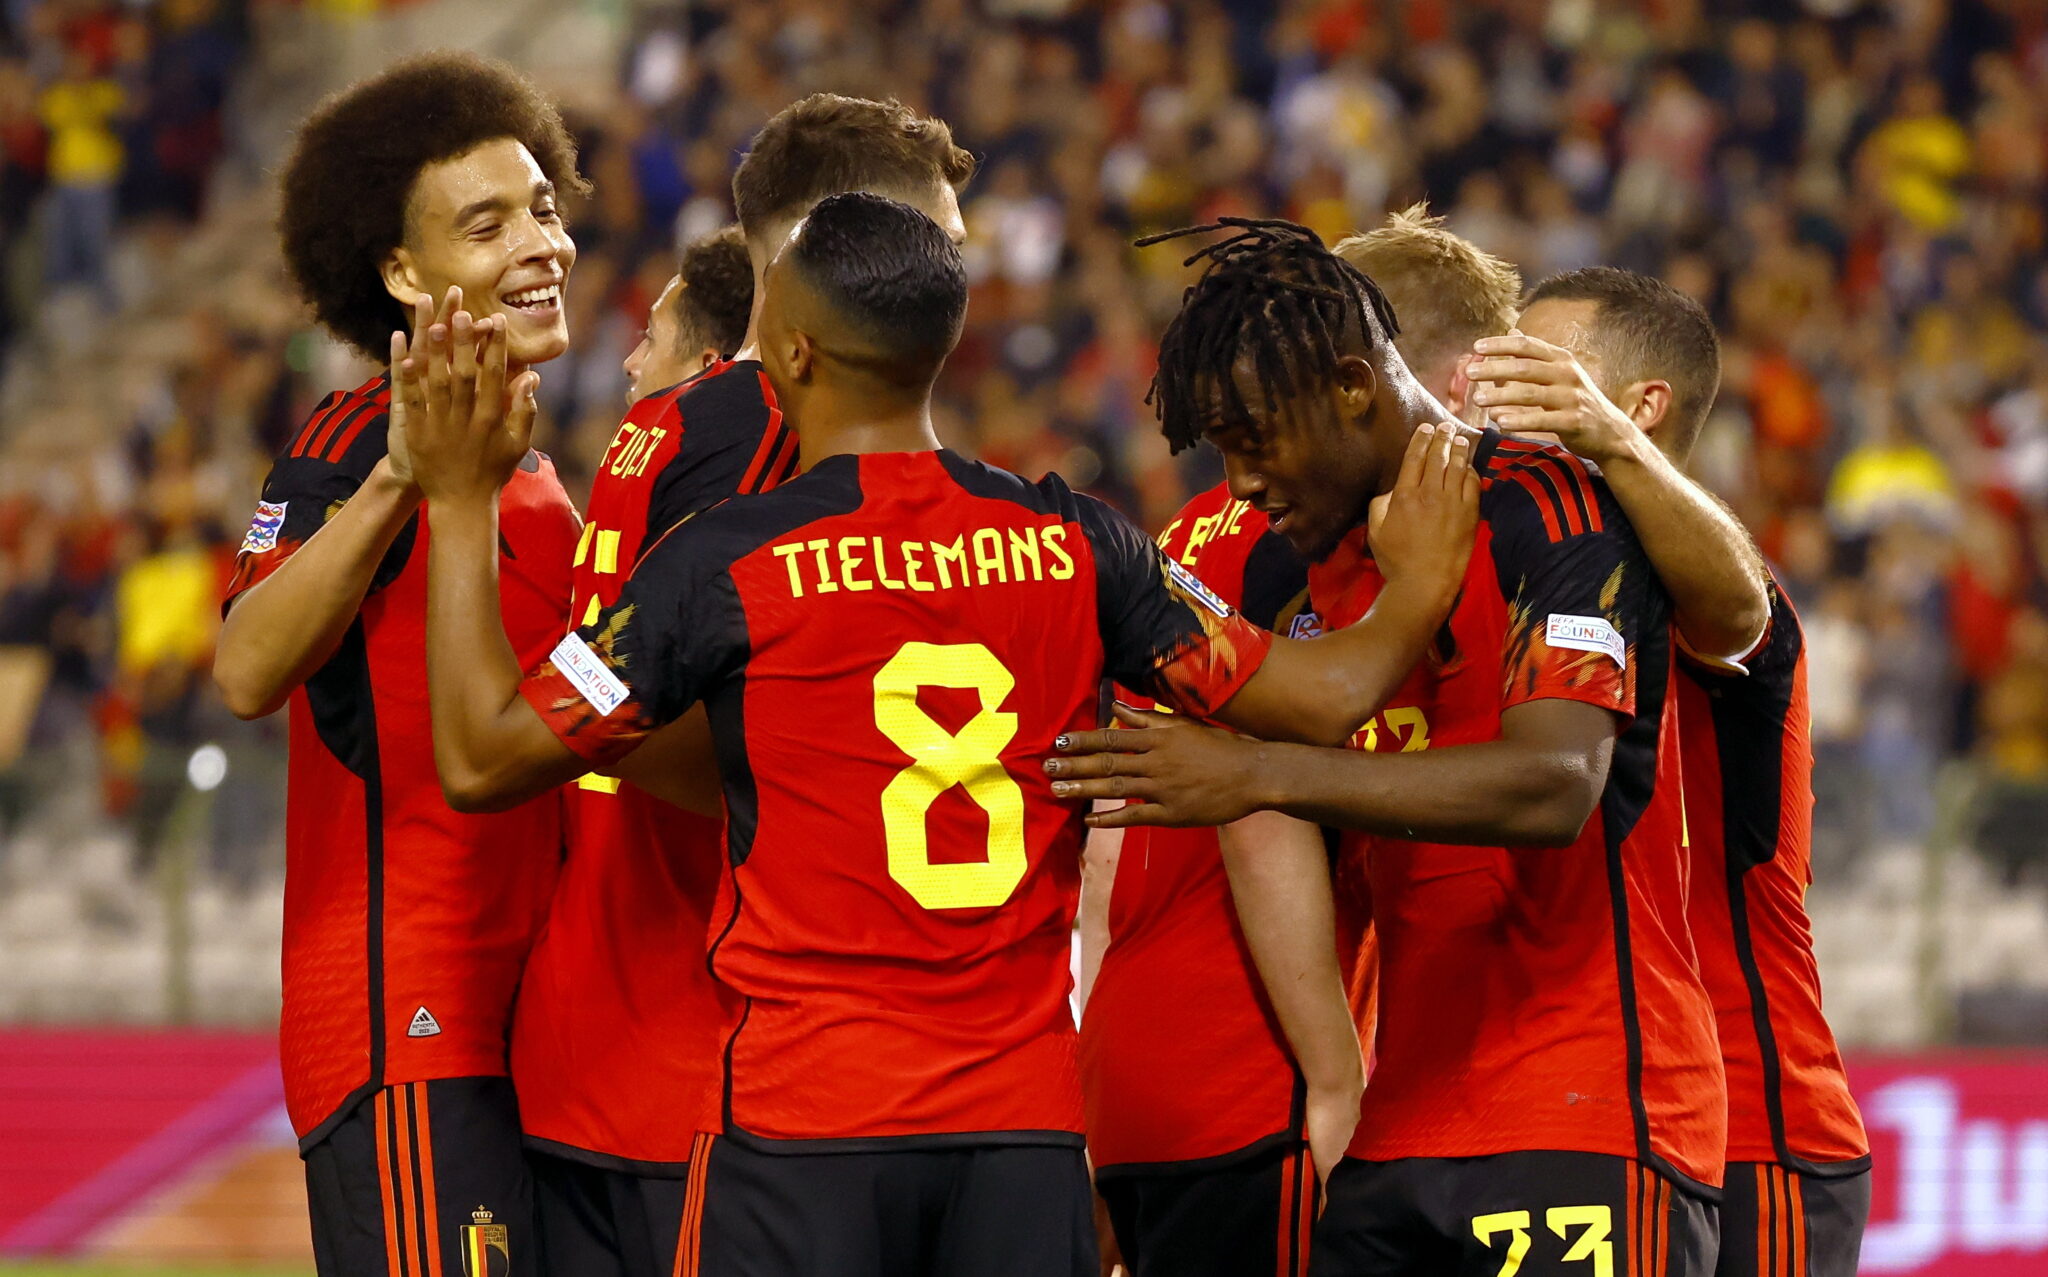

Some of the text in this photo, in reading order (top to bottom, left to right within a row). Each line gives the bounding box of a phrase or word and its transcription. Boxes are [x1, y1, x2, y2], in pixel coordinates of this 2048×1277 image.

[773, 524, 1075, 599] TIELEMANS
[1551, 616, 1574, 625] UEFA
[872, 641, 1028, 910] 8
